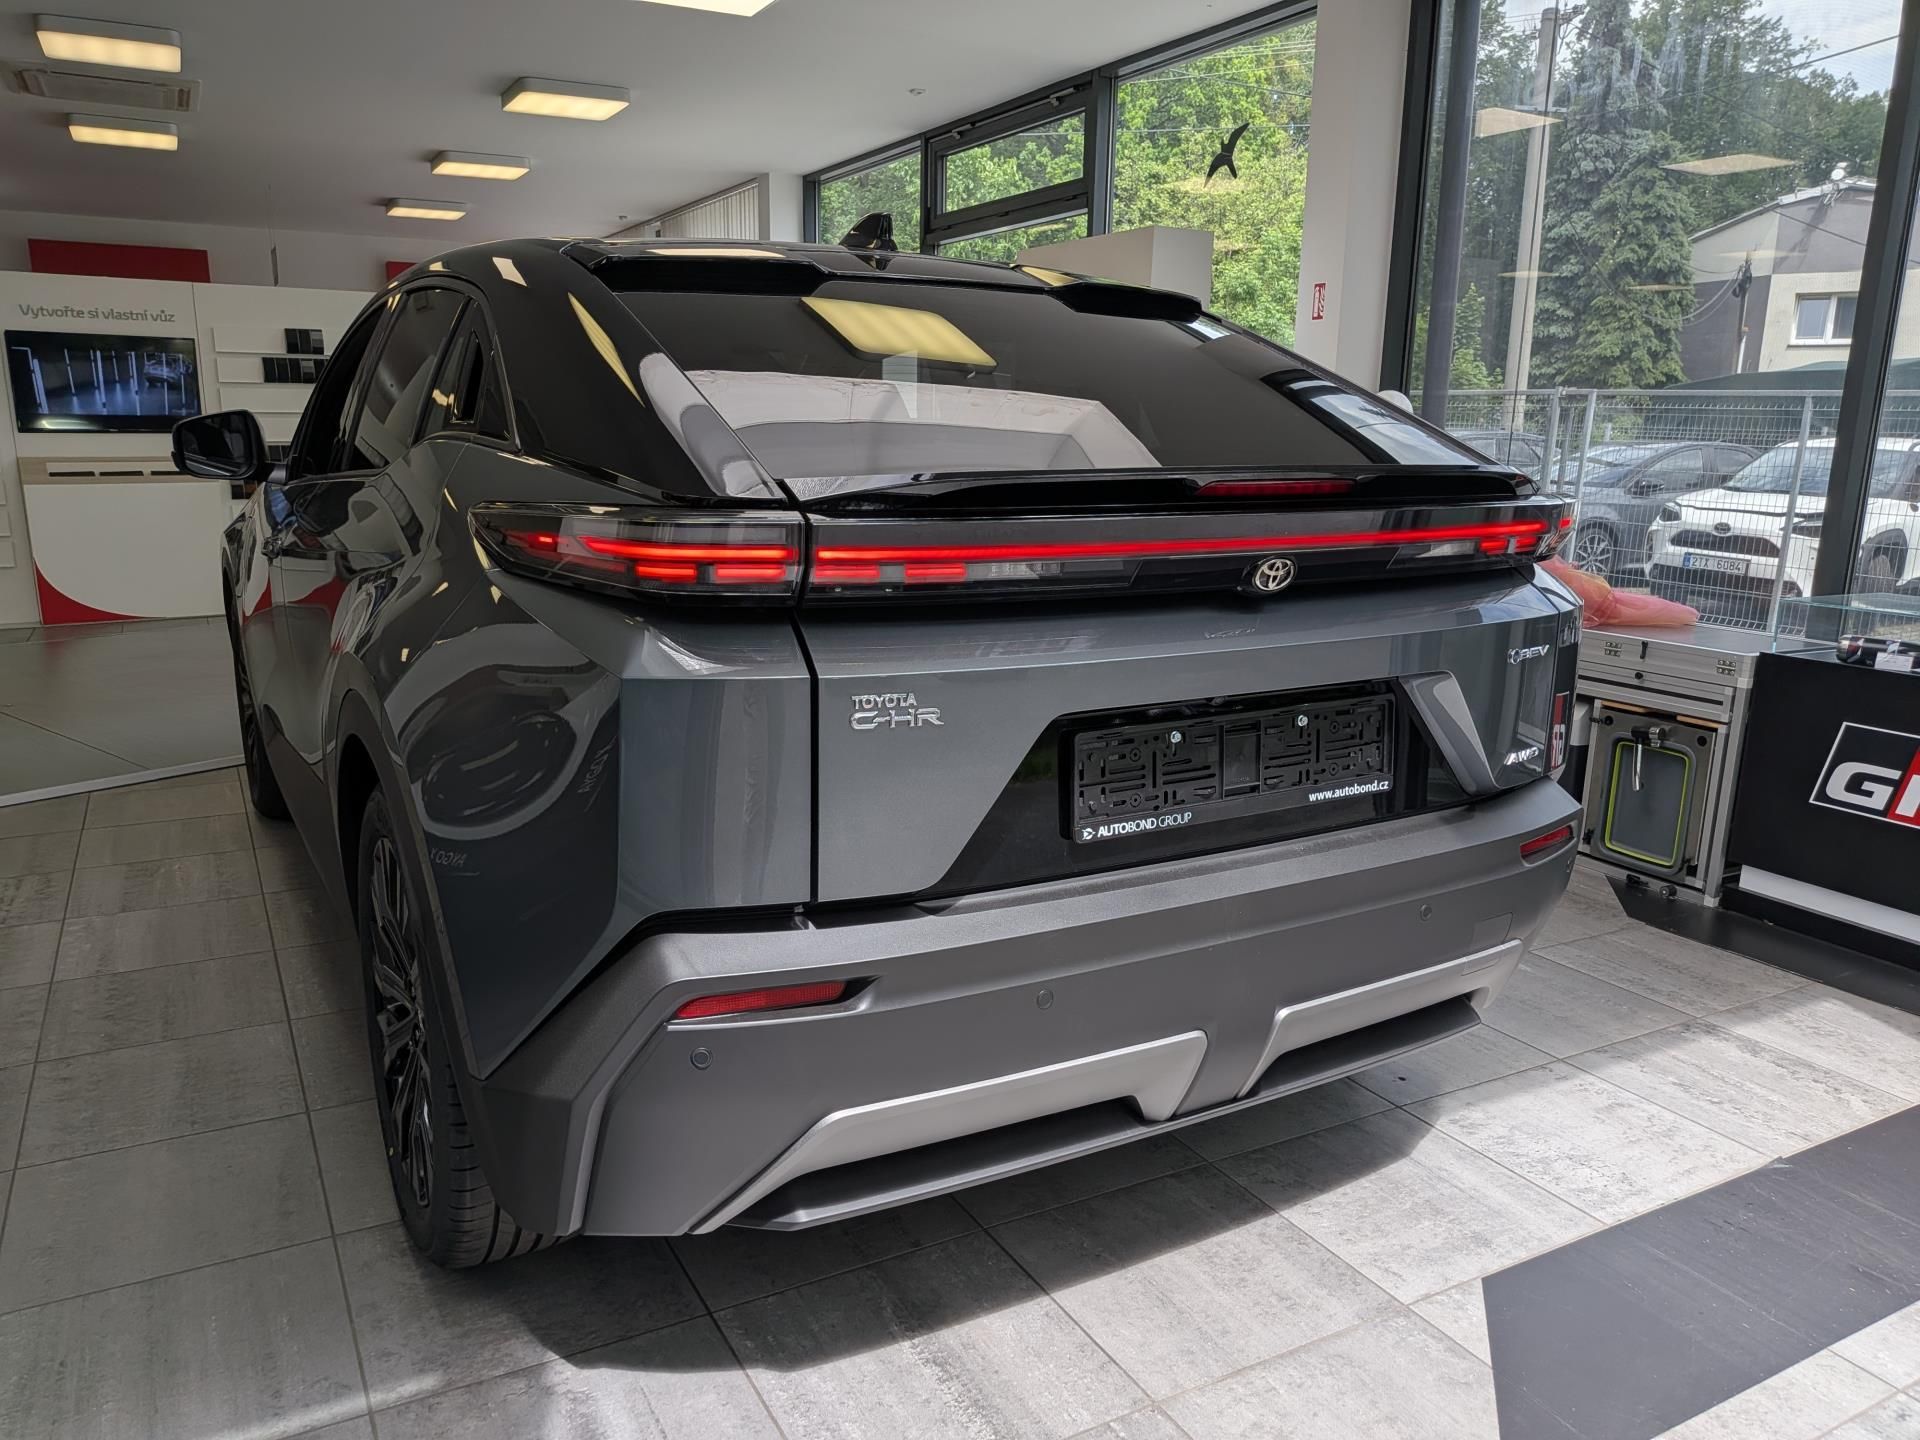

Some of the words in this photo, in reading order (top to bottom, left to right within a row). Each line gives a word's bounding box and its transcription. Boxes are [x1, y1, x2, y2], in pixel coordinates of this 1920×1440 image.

[18, 304, 84, 319] Vytvořte
[87, 307, 99, 319] si
[101, 308, 148, 321] vlastní
[150, 309, 175, 322] vůz
[1716, 559, 1741, 572] 6084
[851, 692, 918, 709] TOYOTA
[850, 707, 945, 730] C-HR
[1505, 747, 1540, 766] AWD
[1308, 779, 1390, 802] www.autobond.cz
[1096, 817, 1157, 838] AUTOBOND
[1158, 812, 1193, 829] GROUP
